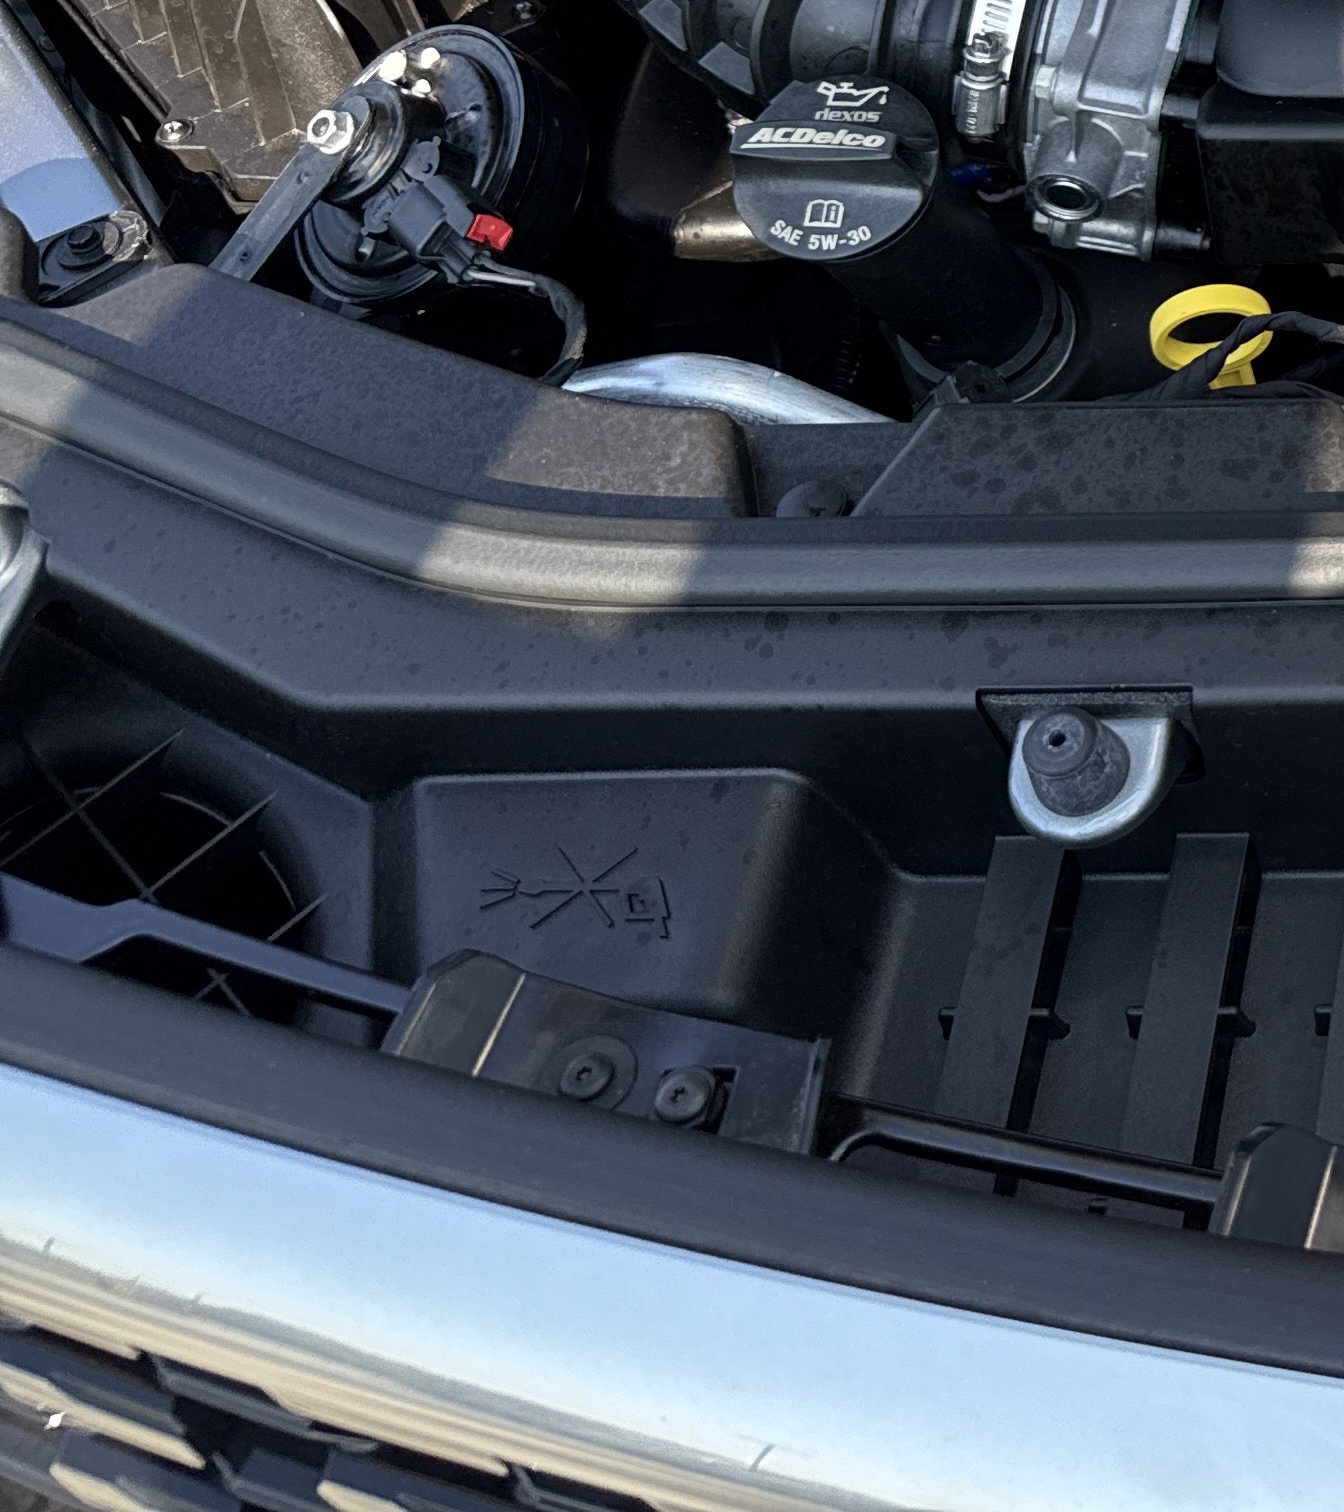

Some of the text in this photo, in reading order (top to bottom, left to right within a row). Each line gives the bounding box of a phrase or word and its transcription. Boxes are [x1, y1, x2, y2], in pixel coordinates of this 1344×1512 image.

[814, 107, 883, 123] dexos
[747, 127, 886, 148] ACDelco
[770, 219, 872, 251] SAE 5W-30
